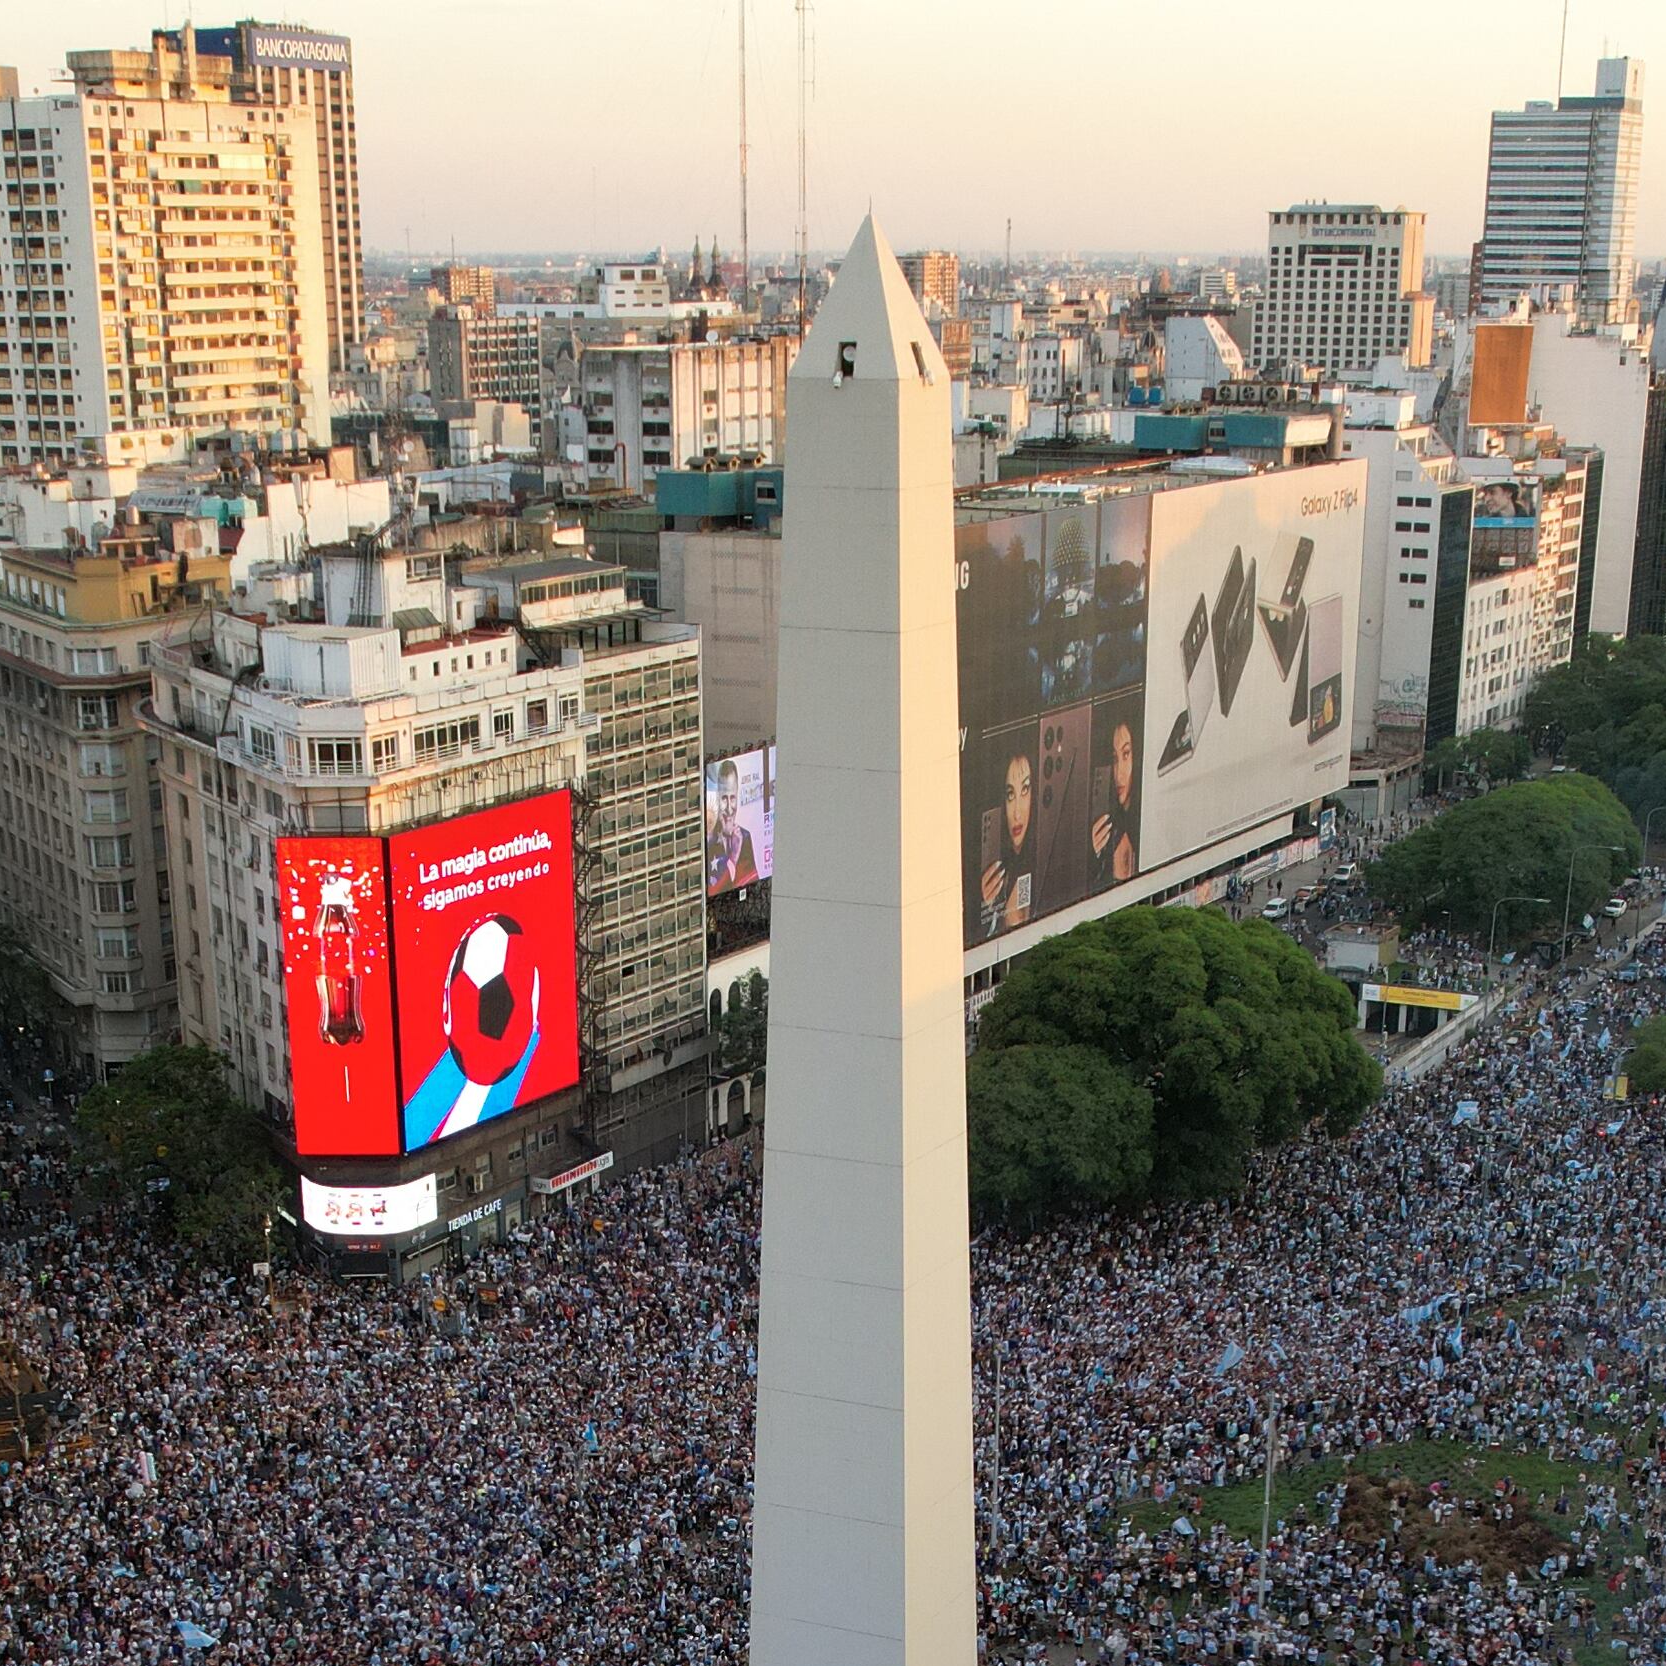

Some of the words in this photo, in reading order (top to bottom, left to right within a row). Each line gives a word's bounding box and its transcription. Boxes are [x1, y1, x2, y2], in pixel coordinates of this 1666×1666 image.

[1301, 494, 1333, 519] Galaxy
[1334, 490, 1339, 510] Z
[419, 863, 440, 884] La
[441, 847, 487, 877] magia
[488, 829, 552, 864] continúa,
[423, 880, 484, 911] sigamos
[487, 862, 550, 891] creyendo
[448, 1211, 474, 1232] TIENDA
[473, 1206, 483, 1221] DE
